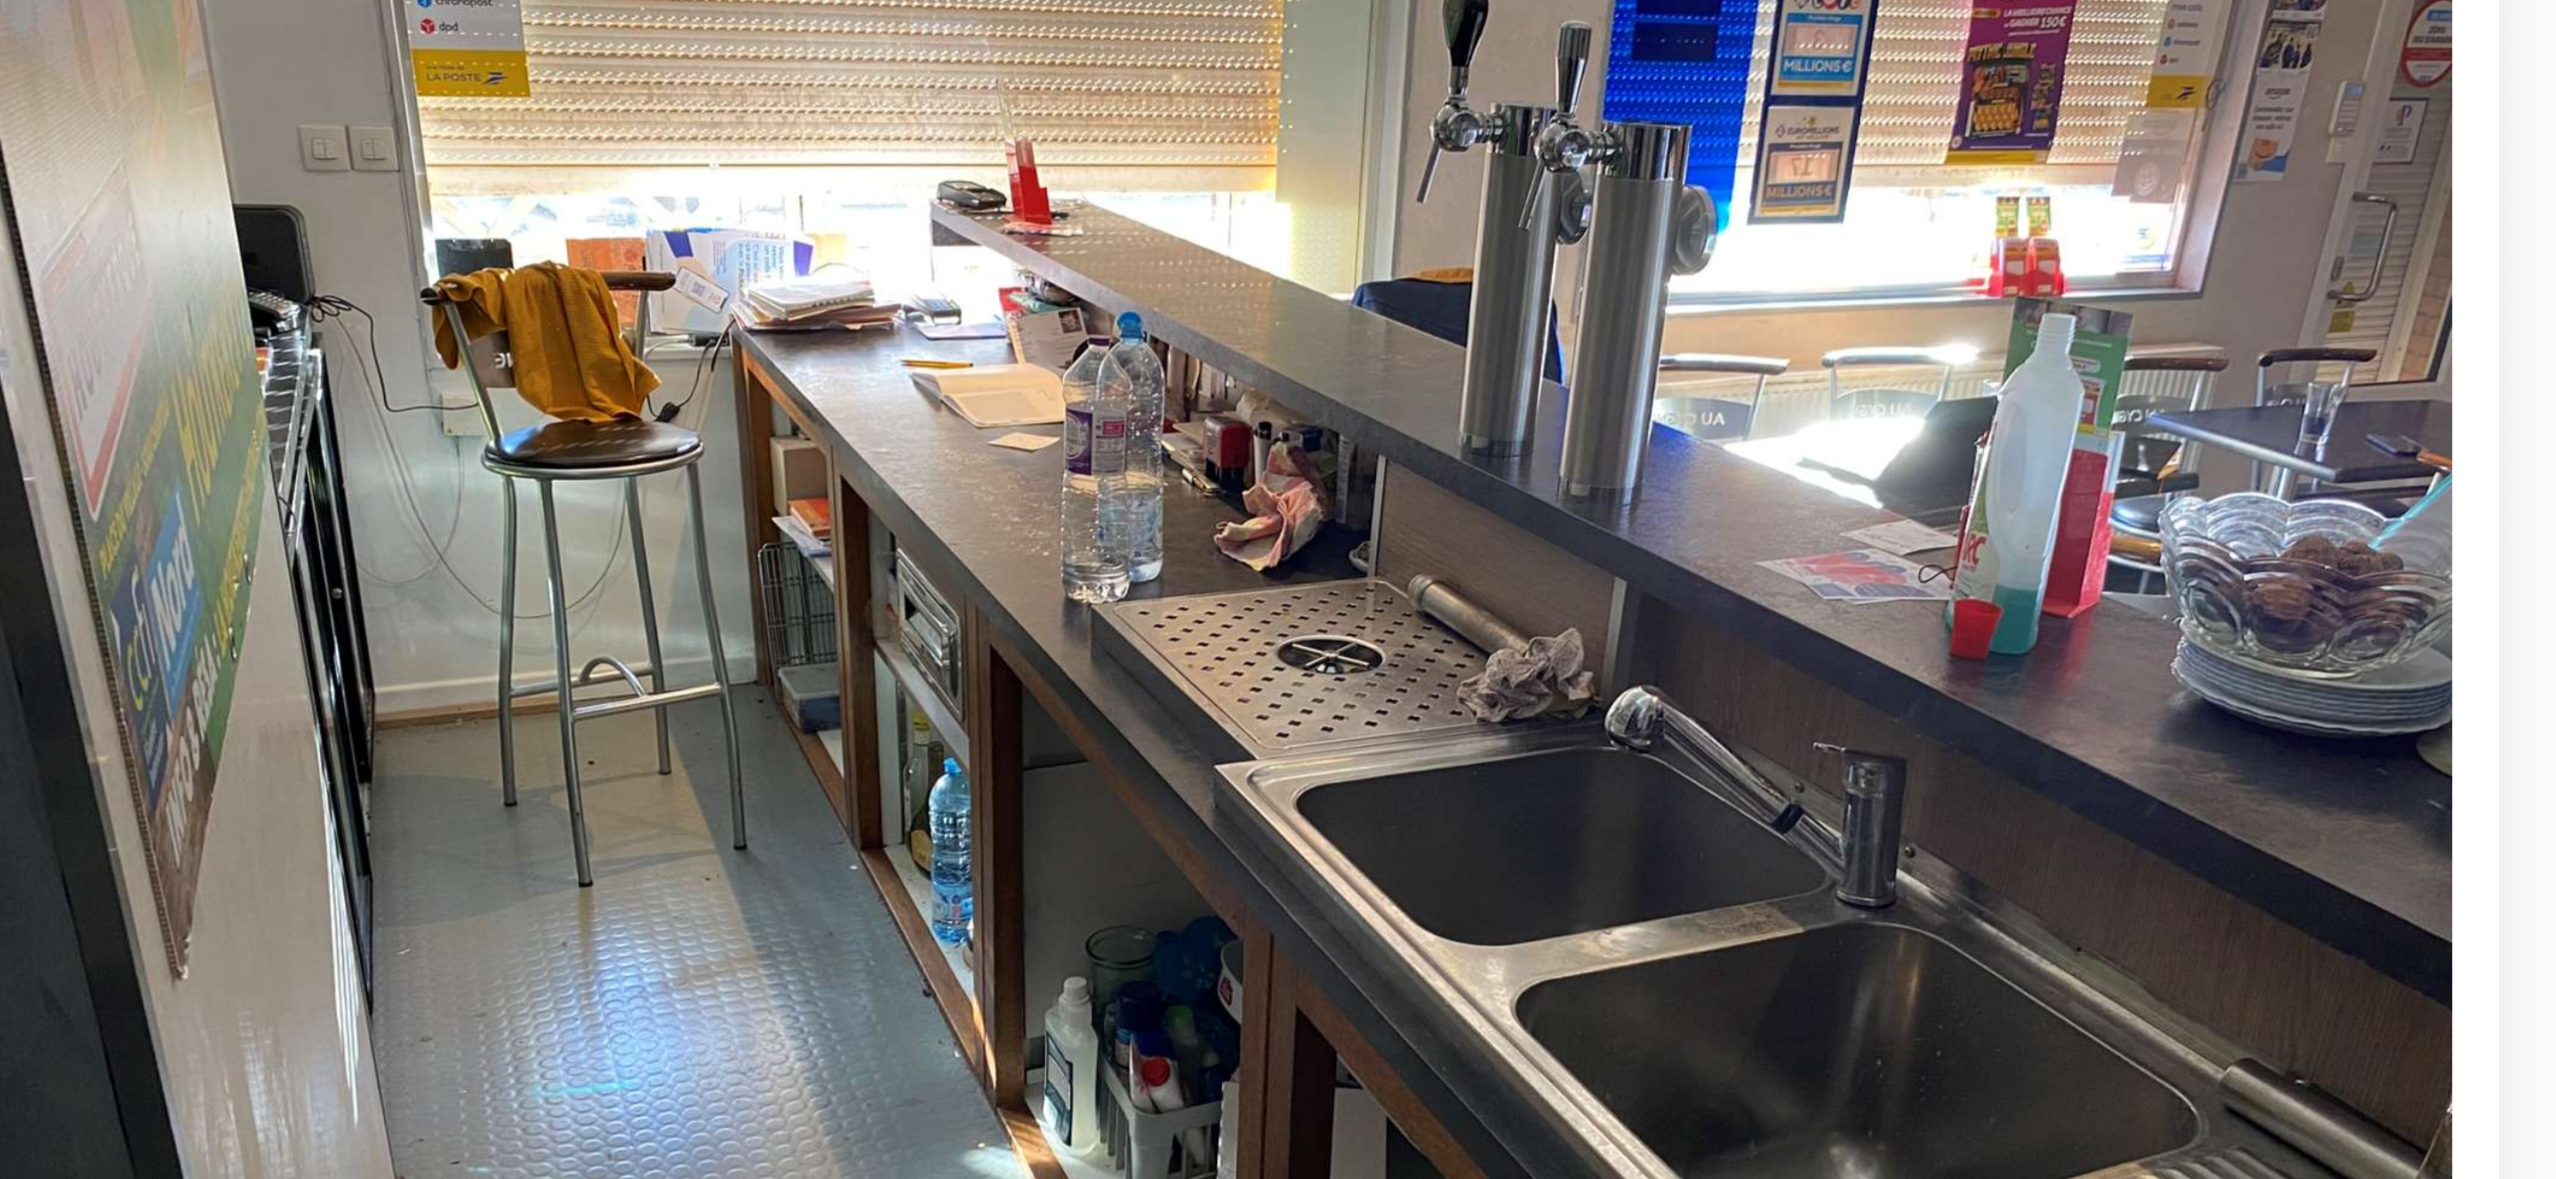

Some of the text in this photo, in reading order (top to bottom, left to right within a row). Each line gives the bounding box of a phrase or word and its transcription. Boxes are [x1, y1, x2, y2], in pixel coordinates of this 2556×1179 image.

[438, 21, 459, 33] dpd
[1782, 59, 1853, 73] MILLIONS €
[426, 73, 482, 82] LA POSTE
[1765, 184, 1824, 198] MILLIONS
[151, 491, 195, 672] Nord
[127, 564, 155, 712] ccfi
[166, 733, 194, 868] INFO
[185, 706, 200, 771] &
